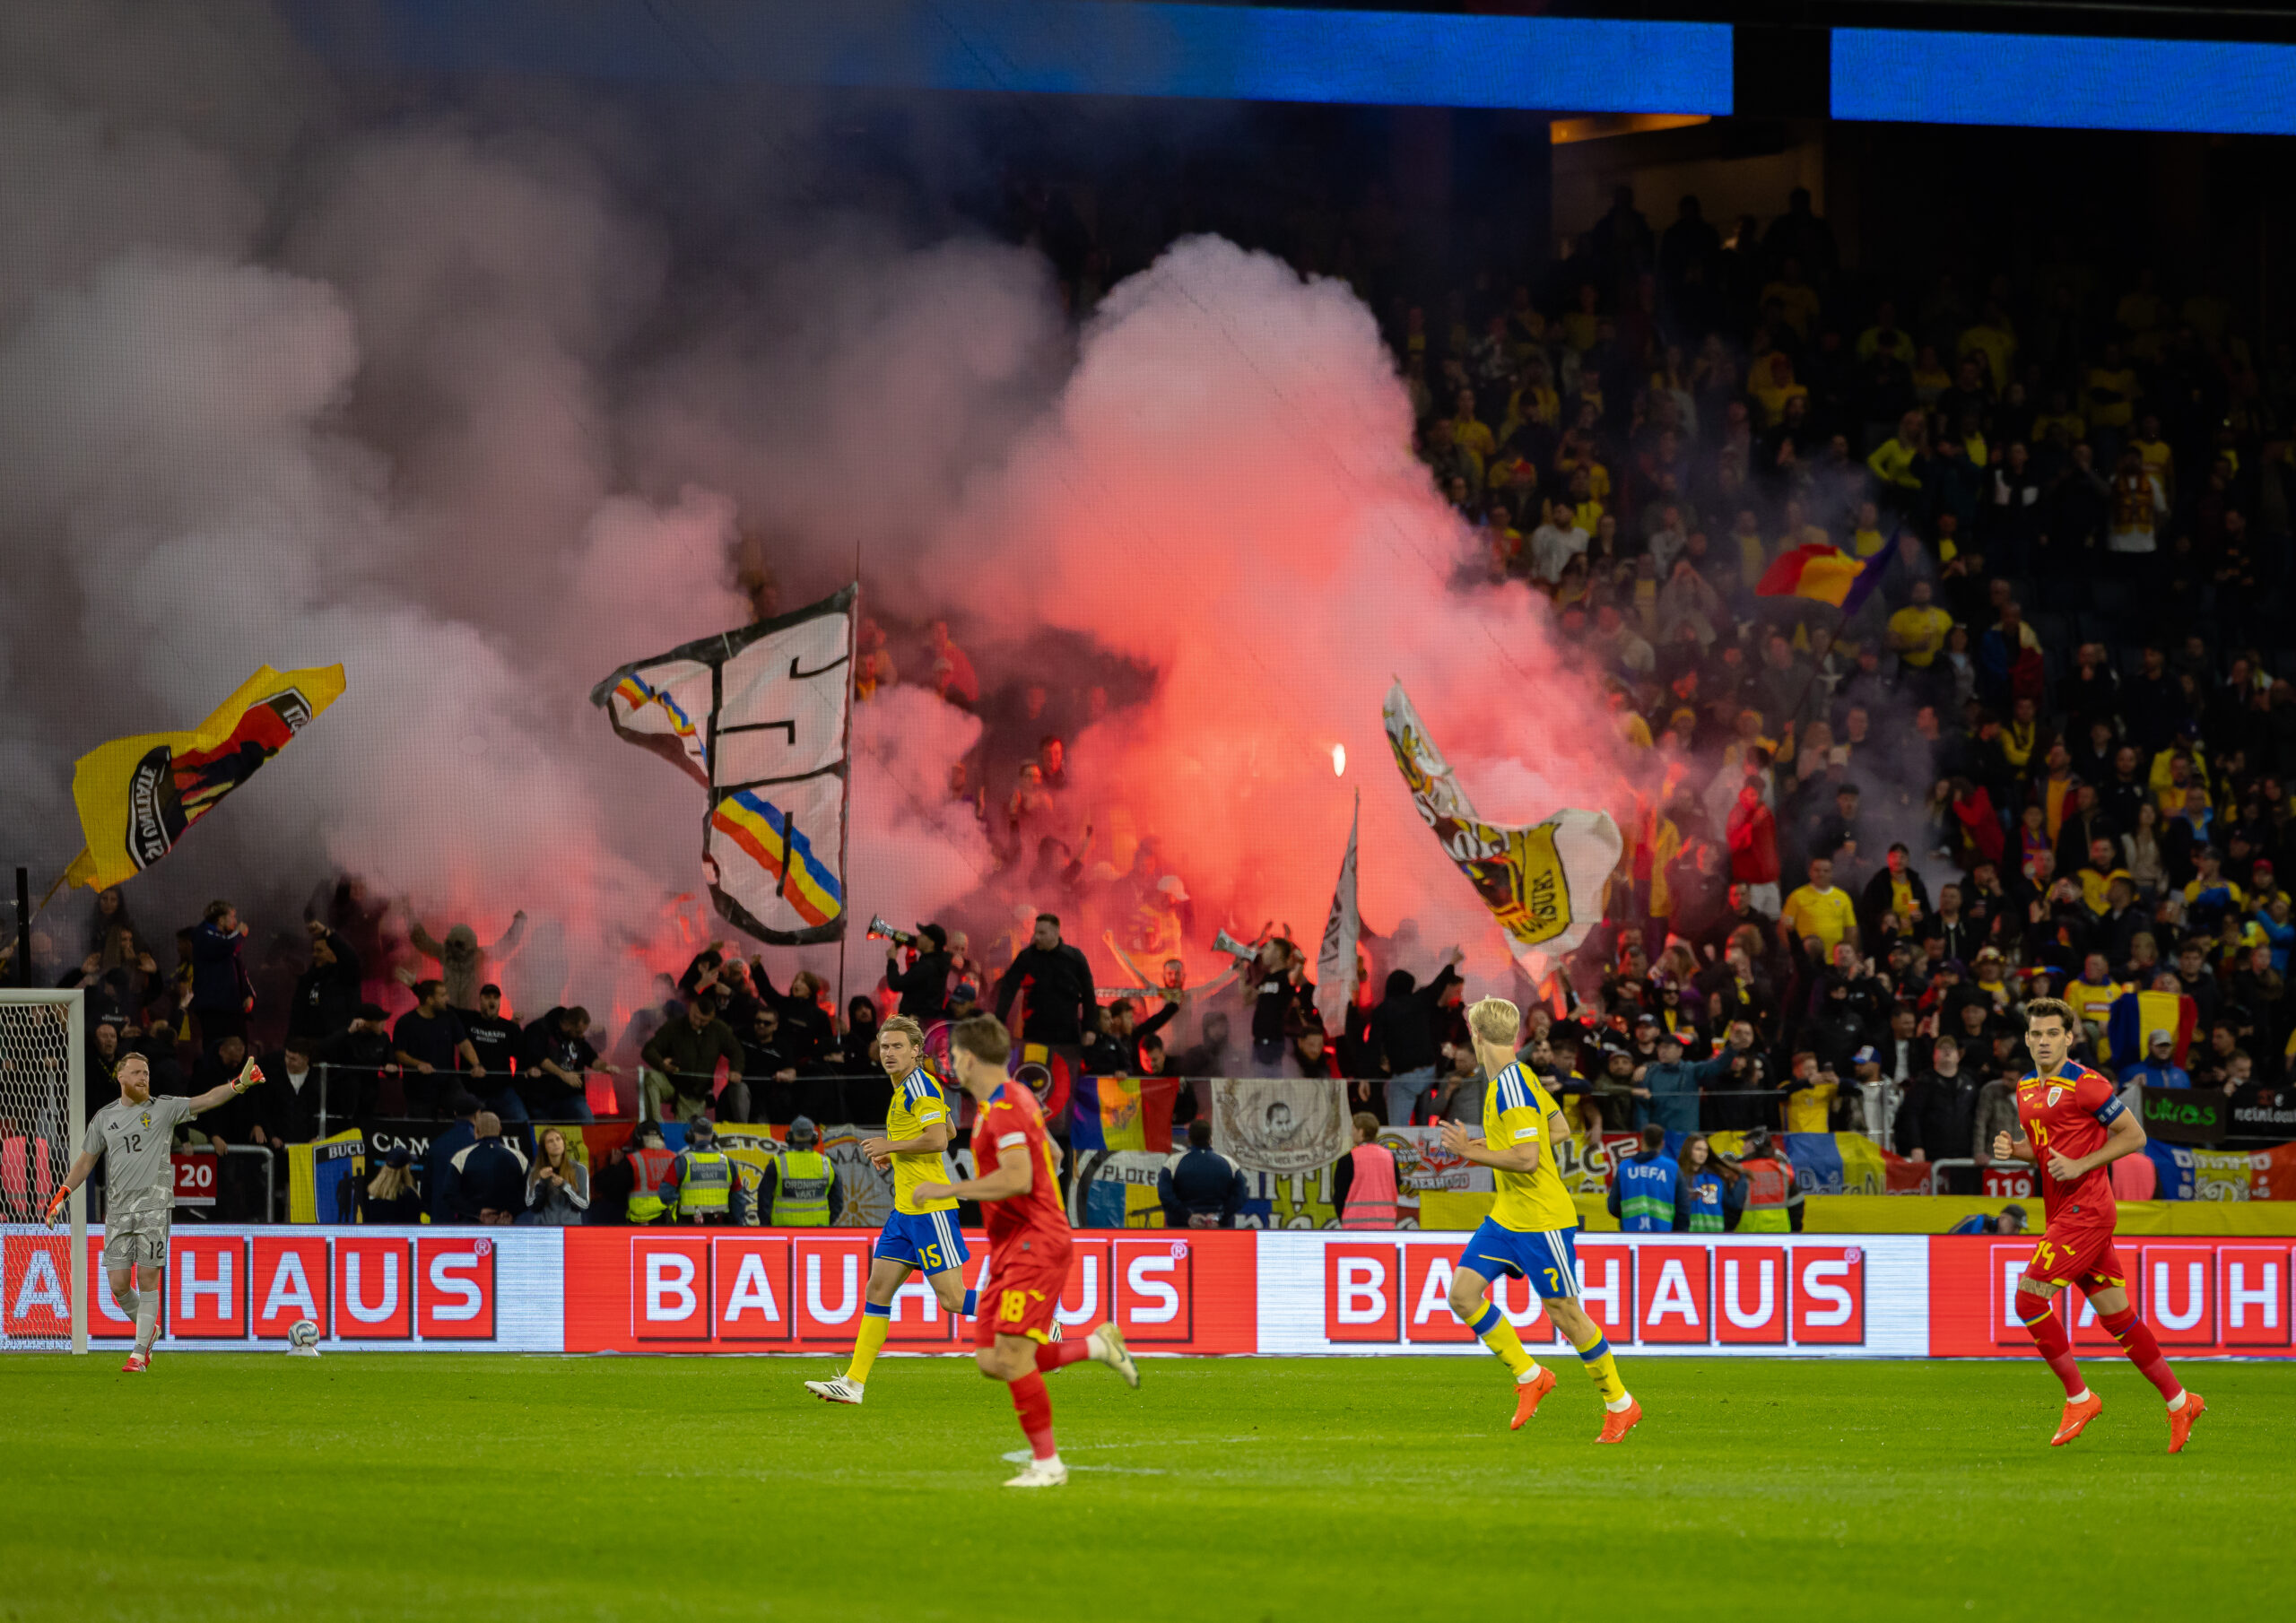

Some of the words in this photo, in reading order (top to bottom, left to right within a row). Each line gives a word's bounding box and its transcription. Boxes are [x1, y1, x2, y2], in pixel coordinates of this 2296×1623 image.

[2030, 1119, 2048, 1145] 14
[123, 1133, 142, 1154] 12
[328, 1139, 365, 1159] BUCU
[1102, 1165, 1157, 1185] PLOIE
[1402, 1174, 1472, 1190] THERHOOD
[1627, 1165, 1667, 1183] UEFA
[796, 1189, 816, 1199] VAKT
[1987, 1178, 2031, 1199] 119
[149, 1240, 164, 1260] 12
[918, 1243, 943, 1270] 15
[2031, 1240, 2056, 1271] 14
[13, 1249, 484, 1323] AUHAUS
[646, 1253, 1179, 1324] BAUHUS
[1544, 1268, 1559, 1292] 7
[1000, 1289, 1027, 1323] 18
